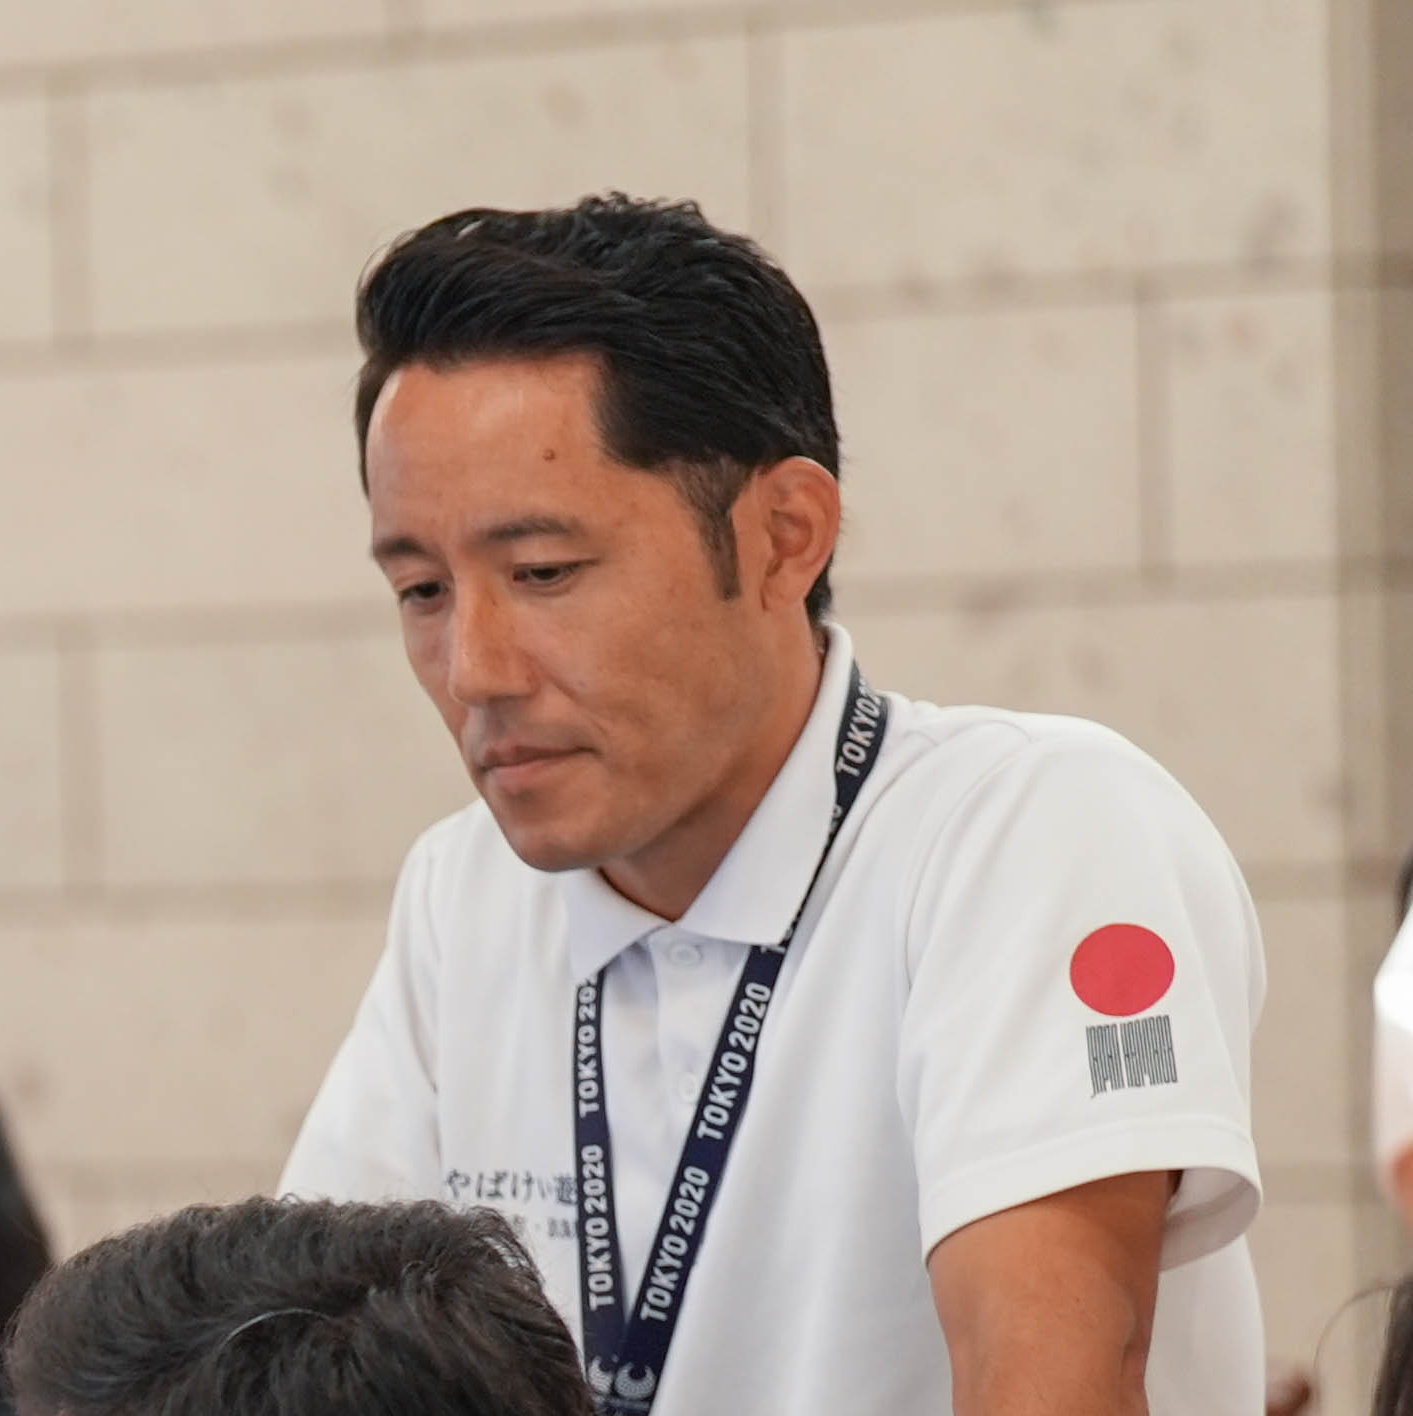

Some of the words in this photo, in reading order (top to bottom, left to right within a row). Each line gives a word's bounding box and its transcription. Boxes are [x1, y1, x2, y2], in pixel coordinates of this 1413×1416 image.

[836, 697, 880, 777] TOKYO
[577, 1024, 600, 1118] TOKYO
[697, 1050, 748, 1141] TOKYO
[728, 982, 772, 1052] 2020
[581, 1144, 607, 1214] 2020
[585, 1218, 615, 1312] TOKYO
[639, 1234, 689, 1323] TOKYO
[669, 1165, 711, 1237] 2020
